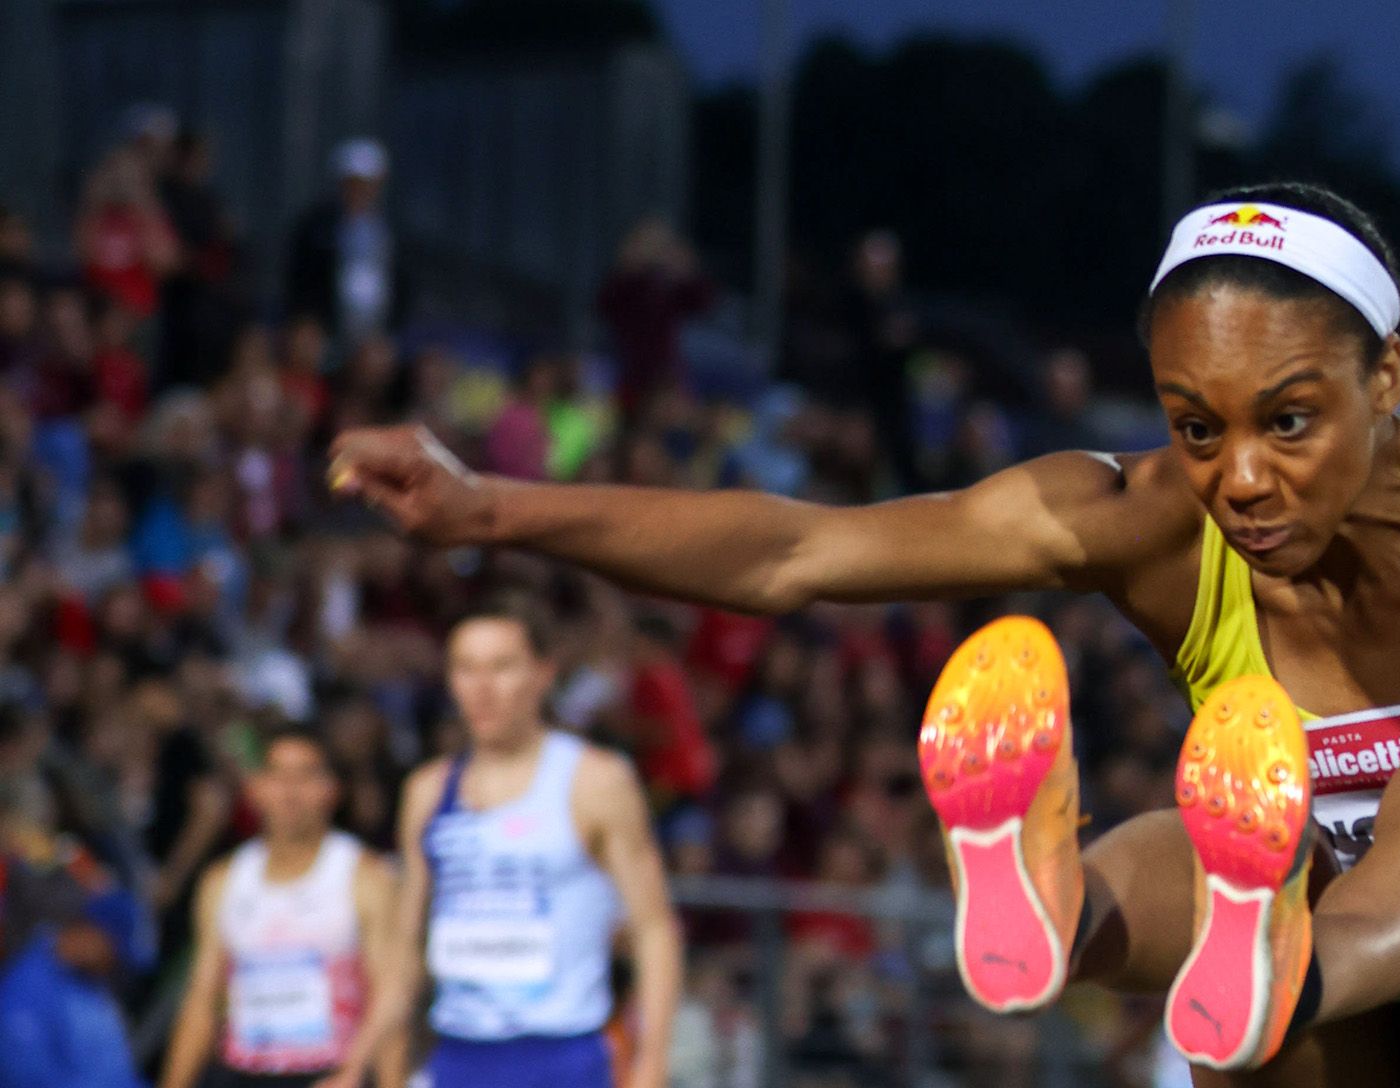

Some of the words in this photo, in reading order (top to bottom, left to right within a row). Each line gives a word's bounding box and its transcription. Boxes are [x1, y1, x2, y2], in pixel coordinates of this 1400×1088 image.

[1193, 230, 1237, 248] Red
[1239, 231, 1284, 250] Bull
[1322, 733, 1362, 745] PASTA
